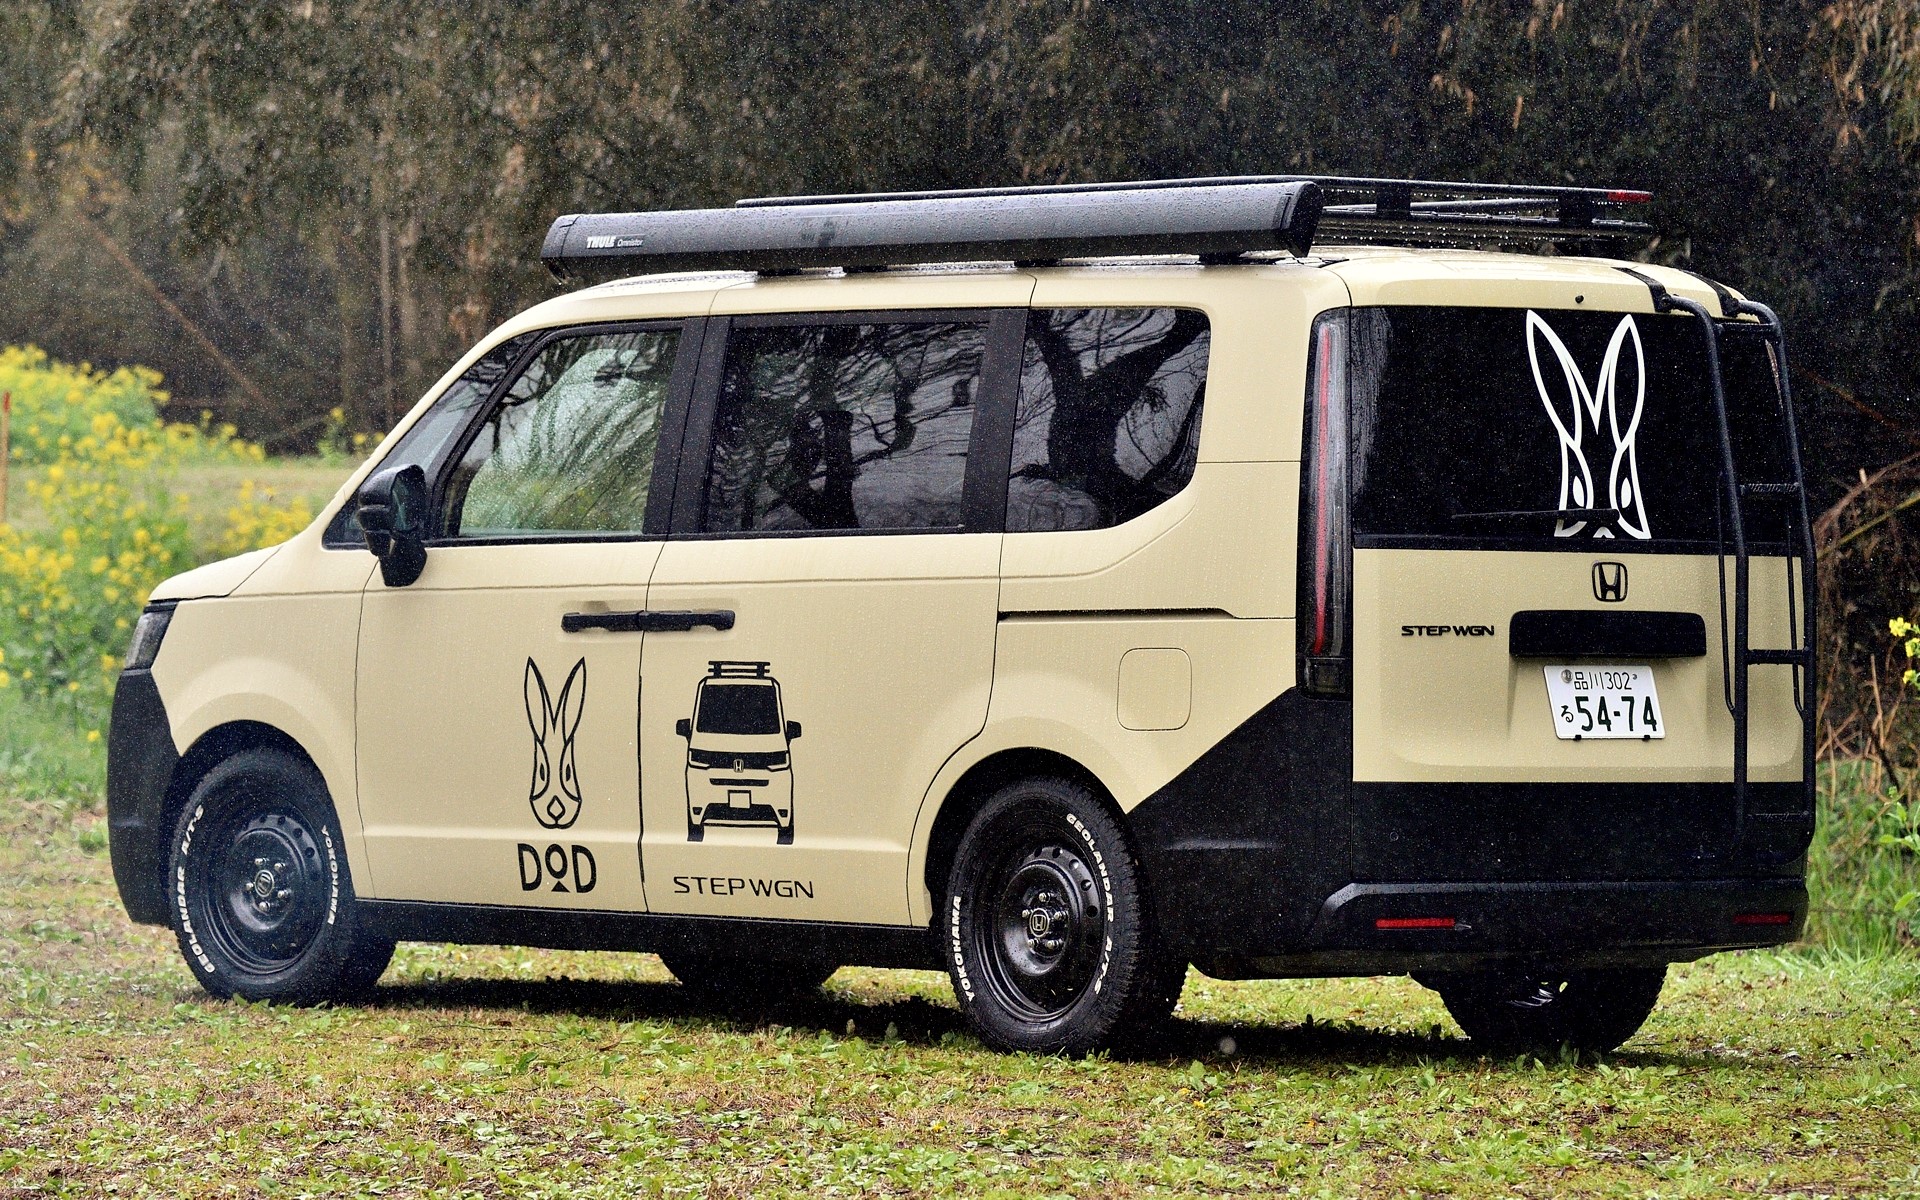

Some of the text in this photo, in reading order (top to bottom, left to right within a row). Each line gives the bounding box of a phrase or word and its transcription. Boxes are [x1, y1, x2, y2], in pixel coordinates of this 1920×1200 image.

[586, 235, 617, 249] THULE
[1561, 696, 1658, 732] る 54-74
[177, 866, 216, 973] GEOLANDAR
[321, 824, 339, 925] YOKOHAMA
[1066, 813, 1114, 923] GEOLANDAR
[951, 895, 976, 1002] YOKOHAMA
